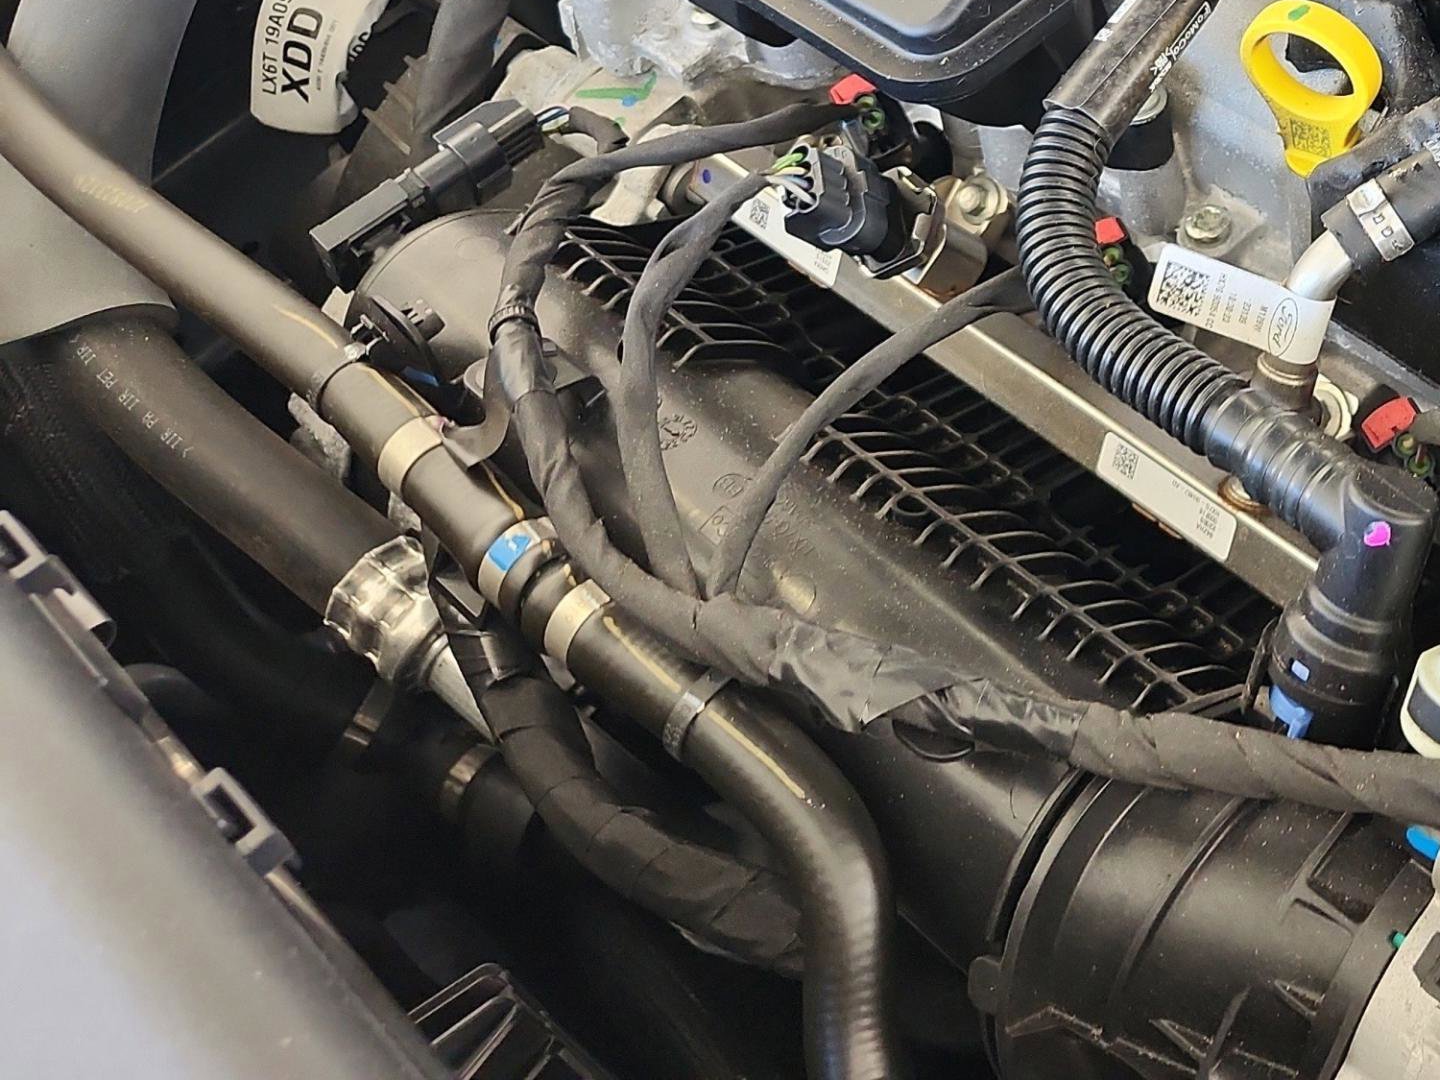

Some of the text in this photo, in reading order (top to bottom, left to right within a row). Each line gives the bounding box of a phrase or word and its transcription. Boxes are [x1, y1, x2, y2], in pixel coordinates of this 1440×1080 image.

[1174, 6, 1212, 55] FoMoCo
[262, 51, 278, 95] LX6T
[281, 7, 324, 103] XDD
[96, 368, 118, 389] PET
